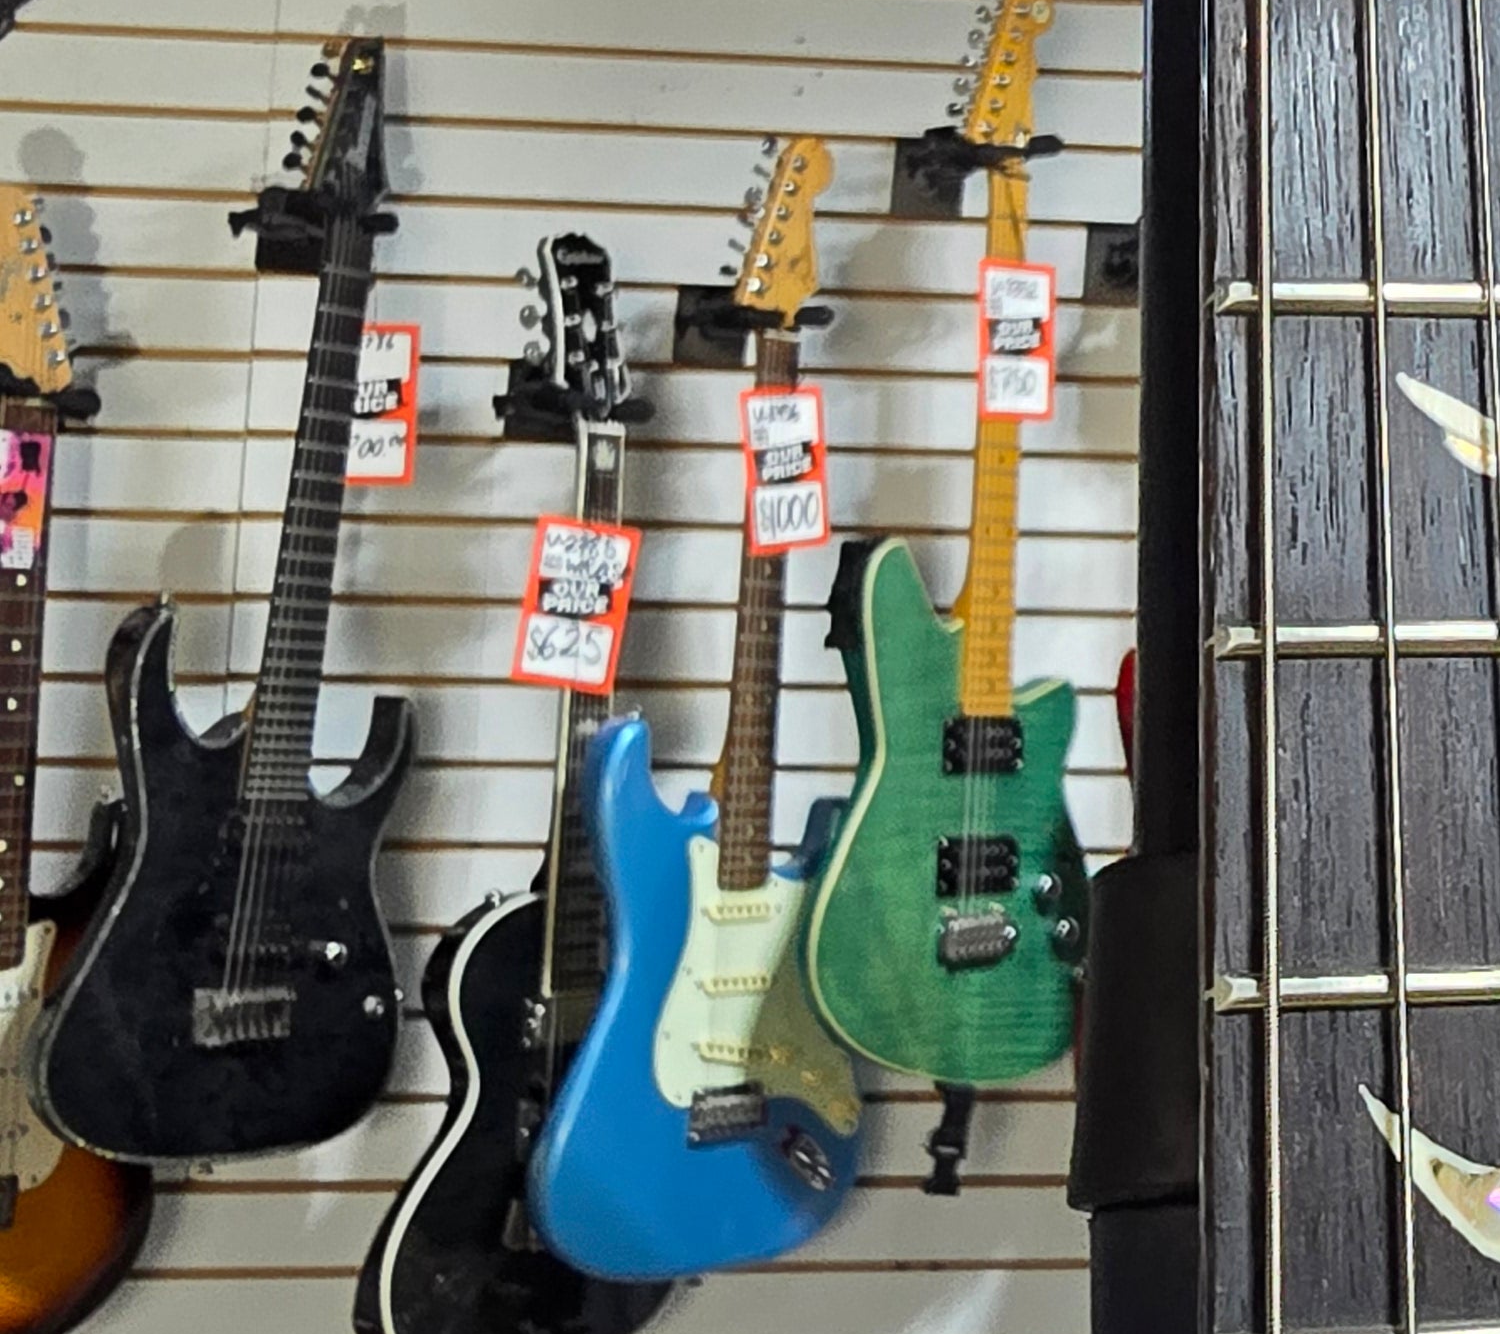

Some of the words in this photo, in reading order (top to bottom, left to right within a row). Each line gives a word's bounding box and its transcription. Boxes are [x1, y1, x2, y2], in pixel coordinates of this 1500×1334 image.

[358, 379, 388, 398] UR
[763, 443, 806, 467] OUR
[761, 454, 814, 483] PRICE
[759, 490, 820, 540] $1000
[551, 577, 601, 600] OUR
[541, 592, 610, 615] PRICE
[526, 621, 603, 666] $625
